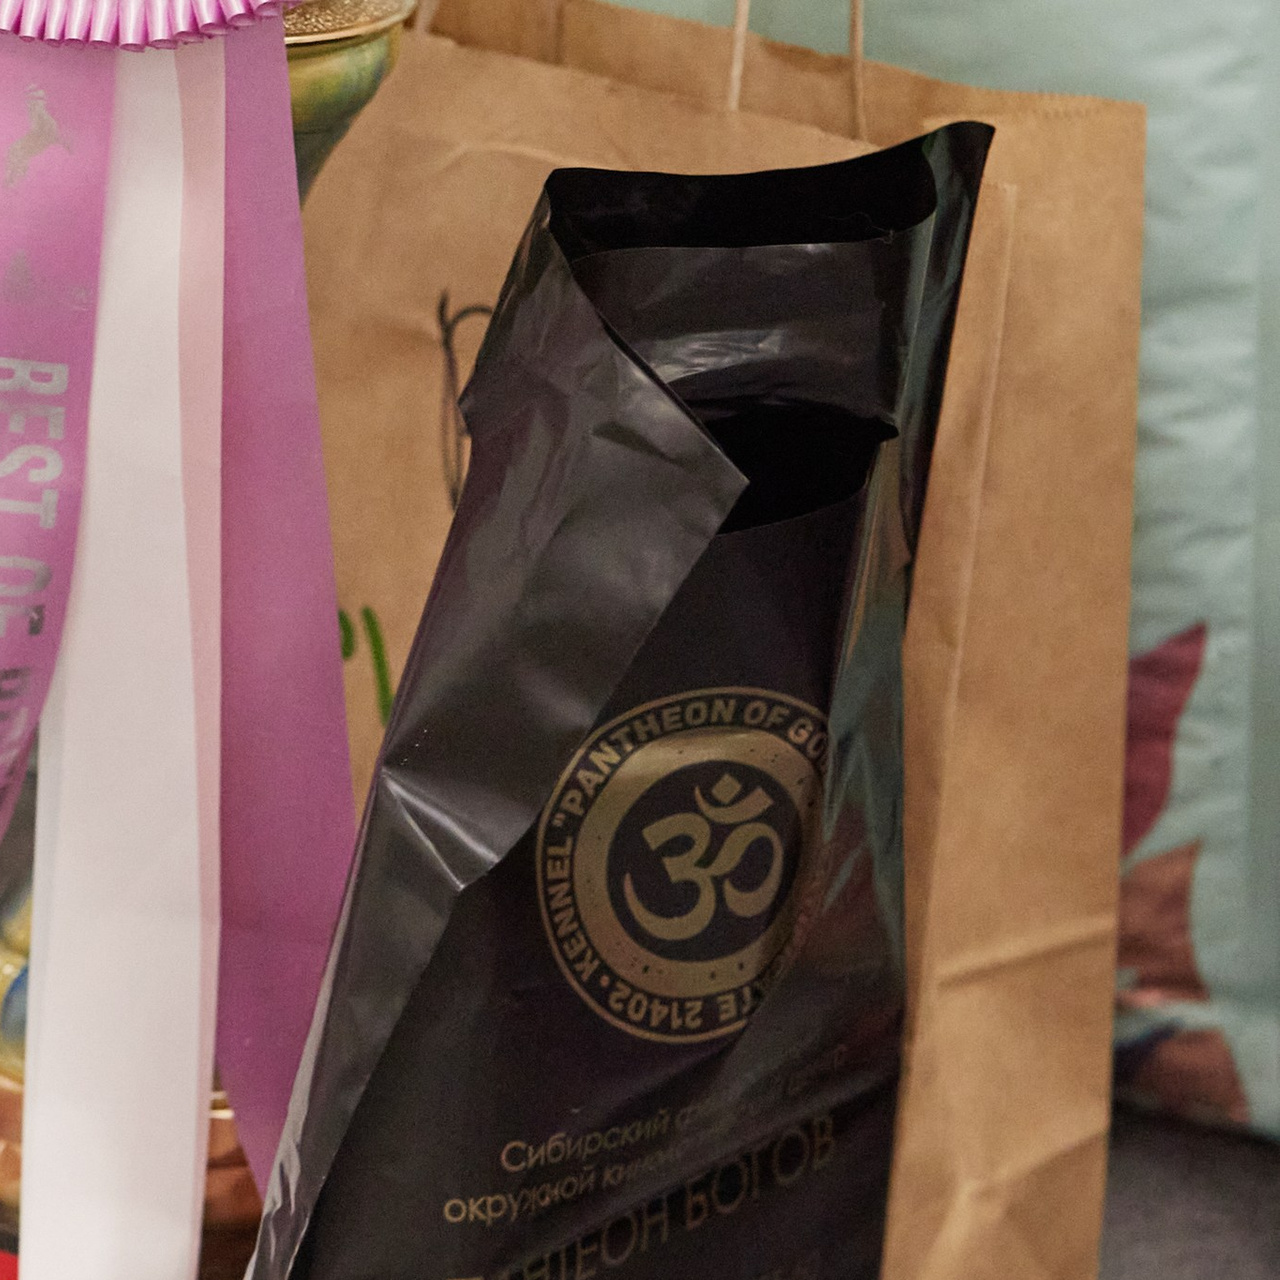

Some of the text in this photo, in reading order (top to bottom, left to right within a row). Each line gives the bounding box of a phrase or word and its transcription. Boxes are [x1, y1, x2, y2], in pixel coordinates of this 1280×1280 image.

[546, 835, 603, 983] KENNEL
[743, 703, 791, 733] OF
[607, 982, 704, 1030] 21402
[500, 1109, 670, 1173] Сибирский
[443, 1164, 597, 1227] окружной
